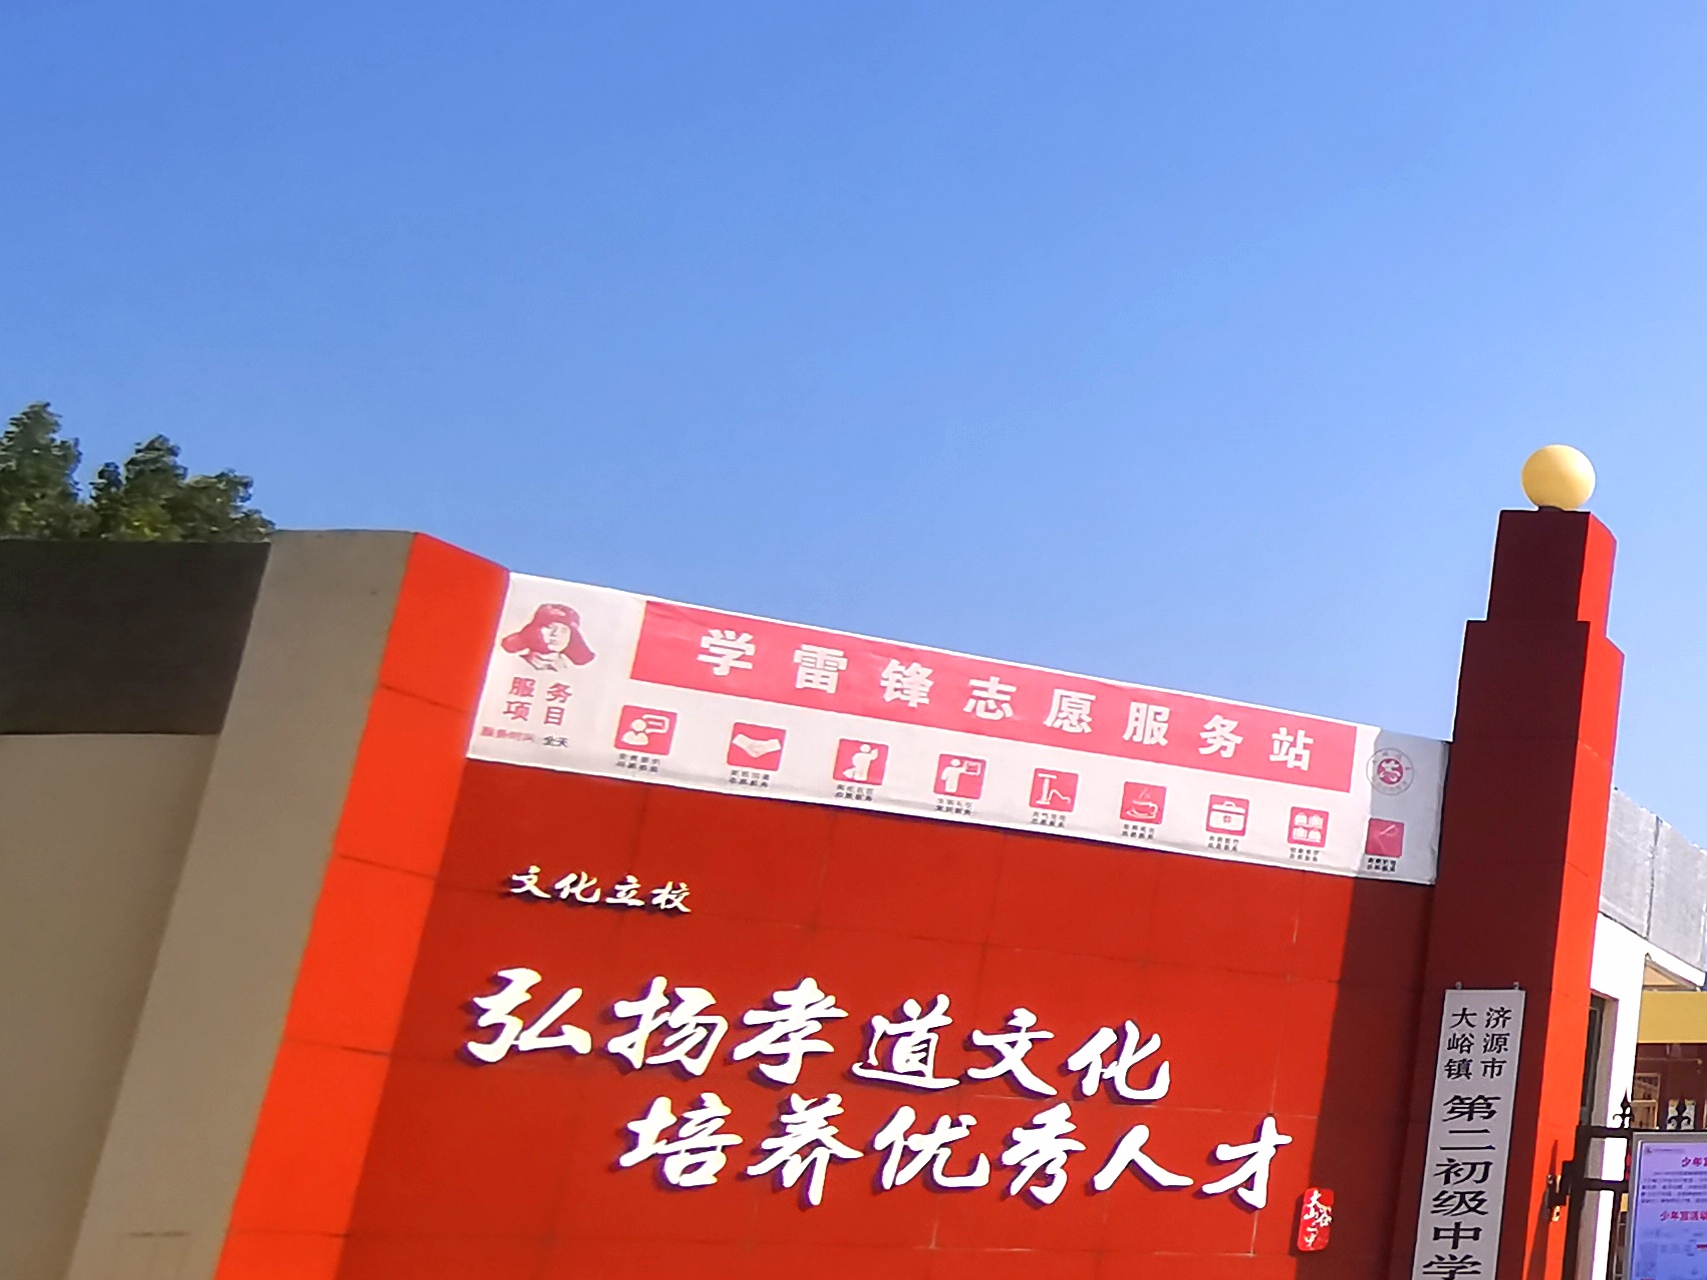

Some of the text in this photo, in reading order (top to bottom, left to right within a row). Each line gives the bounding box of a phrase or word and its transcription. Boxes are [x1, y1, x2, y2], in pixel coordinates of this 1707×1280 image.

[503, 700, 566, 726] 项目
[509, 676, 573, 704] 服务
[697, 628, 1315, 772] 学雷锋志愿服务站
[510, 865, 692, 914] 文化立校
[465, 967, 1172, 1102] 弘扬孝道文化
[1443, 1007, 1478, 1080] 大峪镇
[1480, 1006, 1512, 1079] 济源市
[616, 1093, 1293, 1210] 培养优秀人才
